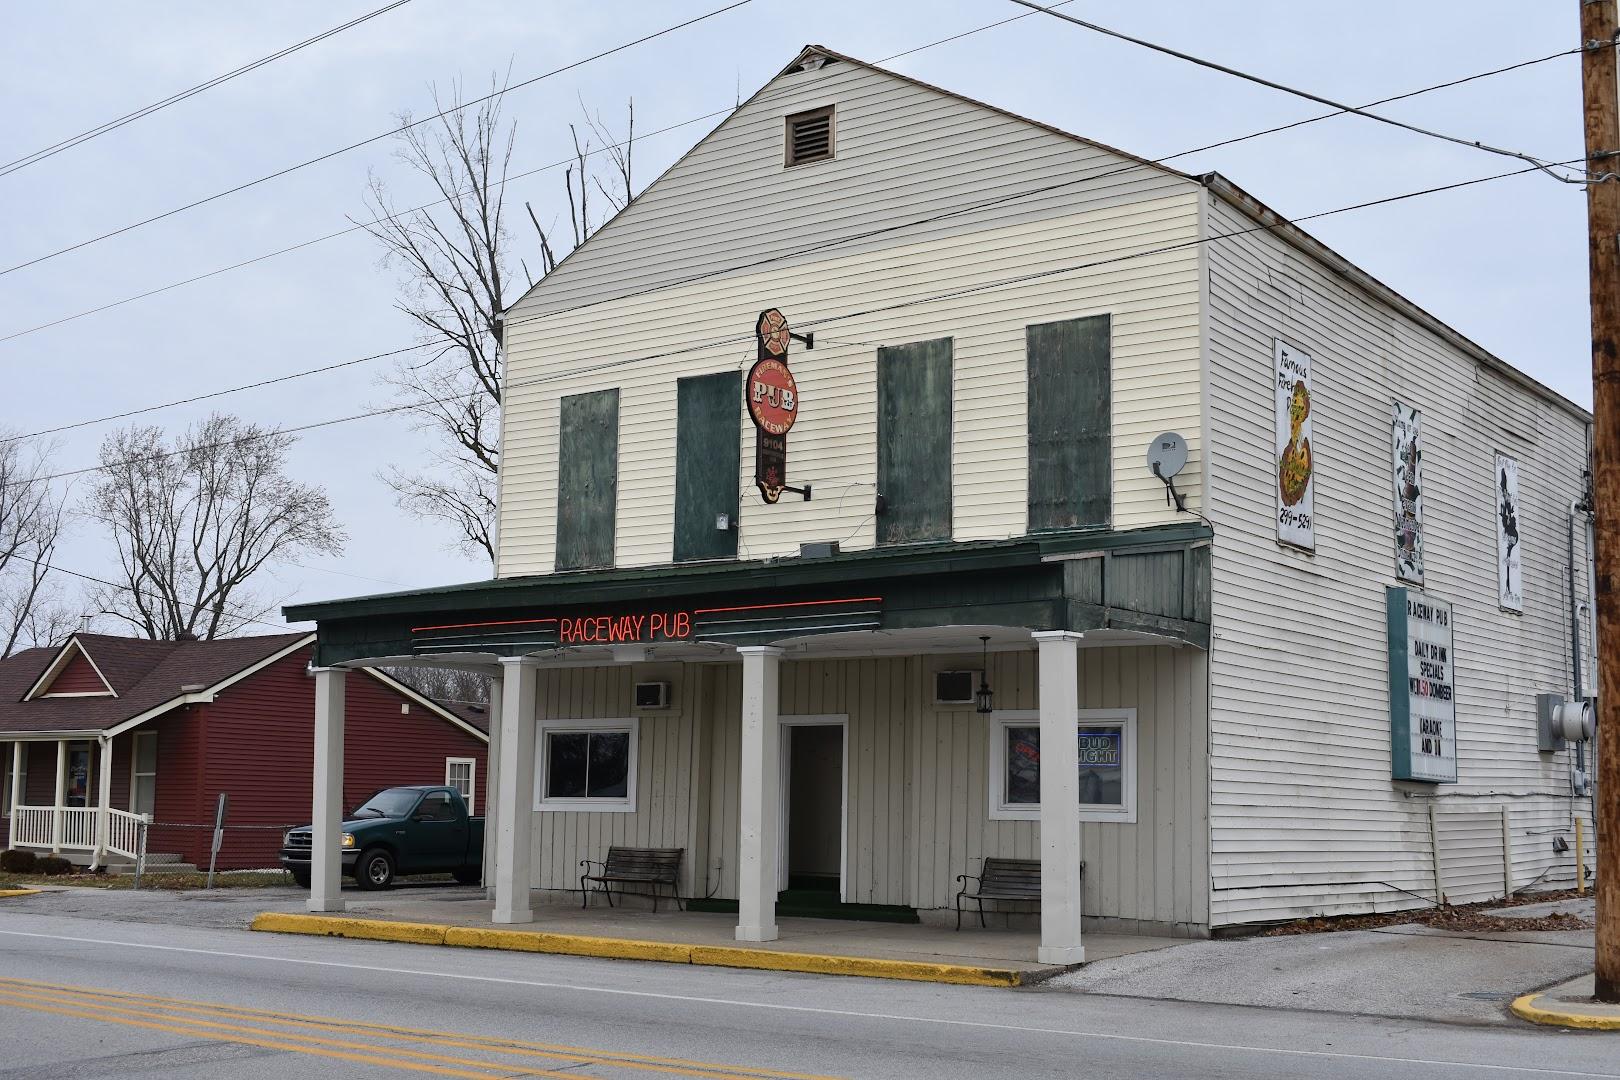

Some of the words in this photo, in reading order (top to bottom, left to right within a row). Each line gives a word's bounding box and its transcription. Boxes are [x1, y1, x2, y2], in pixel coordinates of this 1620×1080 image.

[1281, 350, 1307, 378] Famous
[753, 380, 795, 411] PUB
[754, 406, 792, 433] RACEWAY
[1408, 600, 1433, 622] RACEWAY
[1436, 608, 1448, 626] PUB
[560, 615, 645, 642] RACEWAY
[650, 612, 690, 639] PUB
[1415, 641, 1429, 659] DAILY
[1420, 661, 1444, 681] SPECIALS
[1420, 718, 1443, 738] KARAOKE
[1079, 736, 1110, 750] BUD
[1422, 739, 1432, 755] AND
[1078, 749, 1118, 763] IGHT
